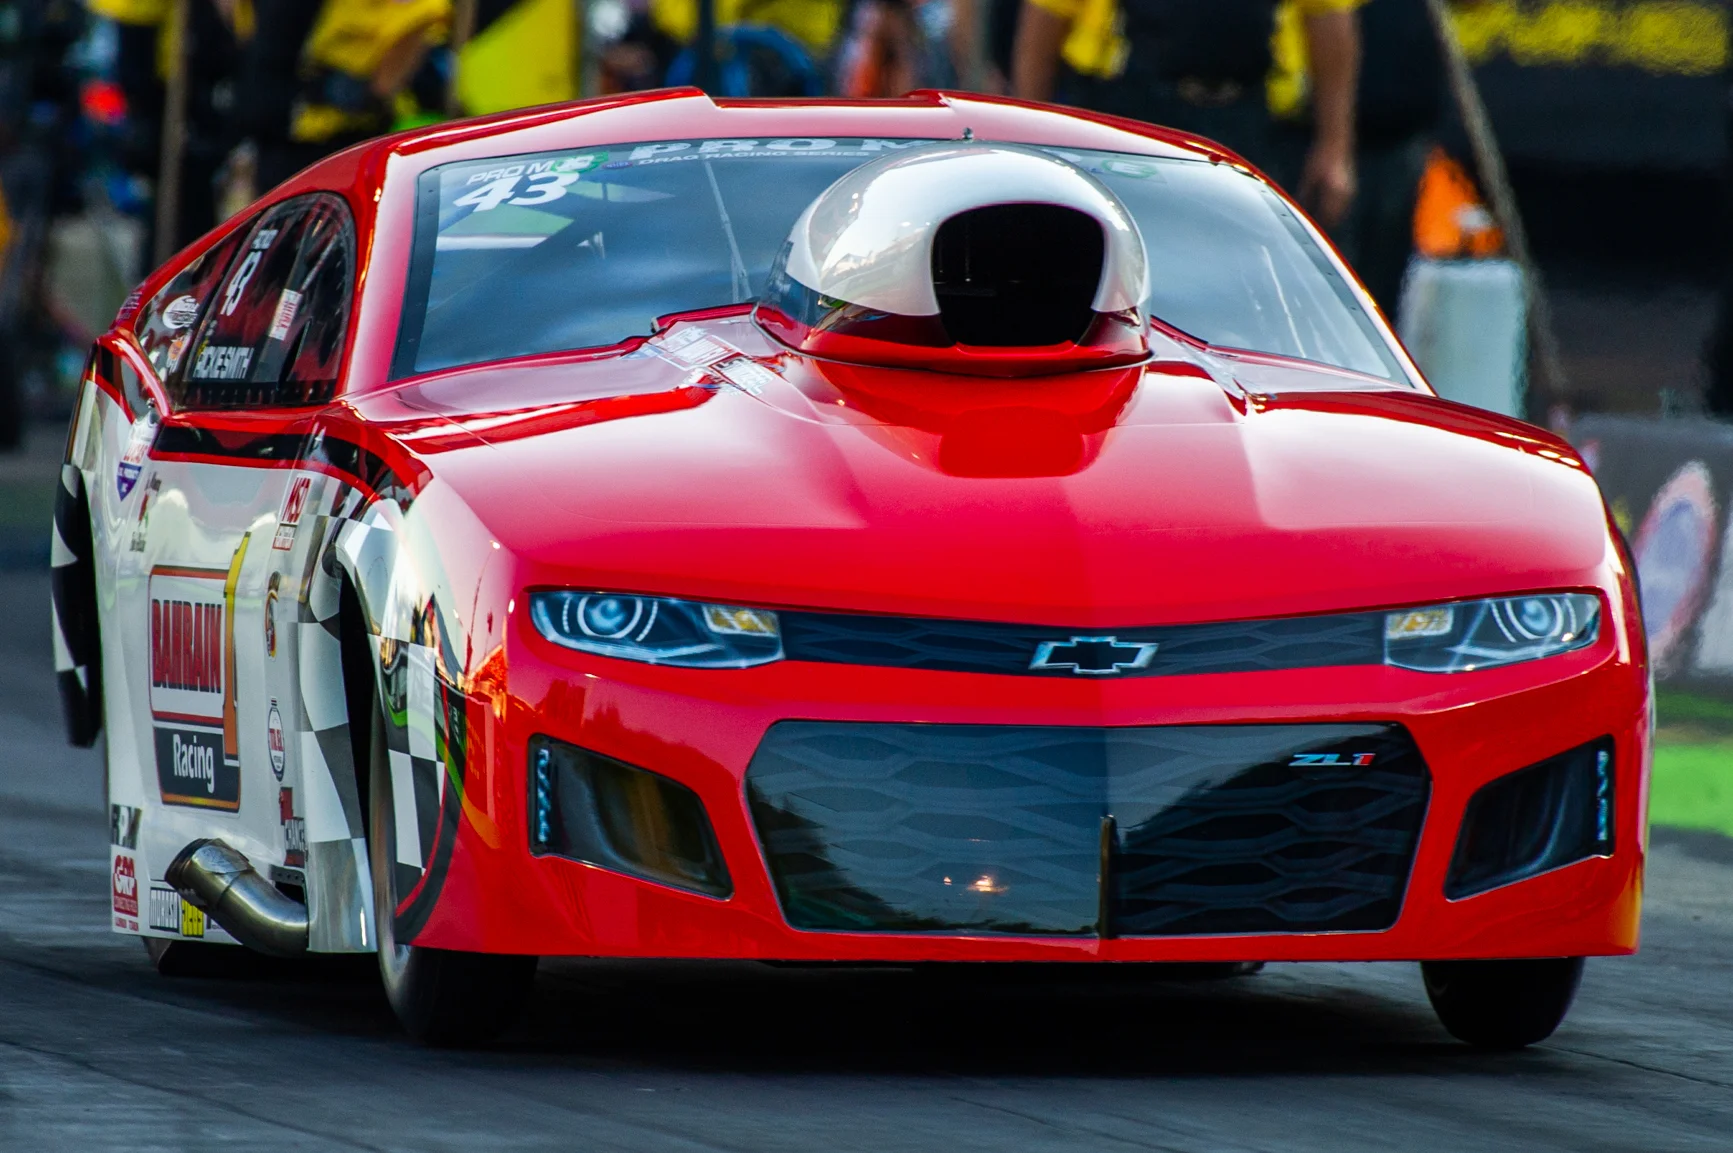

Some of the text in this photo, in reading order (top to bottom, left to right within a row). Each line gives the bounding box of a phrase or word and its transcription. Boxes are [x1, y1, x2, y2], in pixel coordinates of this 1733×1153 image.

[628, 138, 837, 160] PRO
[638, 155, 698, 165] DRAG
[705, 150, 787, 159] RACING
[466, 165, 525, 185] PRO
[453, 171, 580, 212] 43
[220, 251, 262, 316] 43
[152, 599, 222, 694] BAHRAIN
[173, 734, 215, 794] Racing
[1288, 753, 1376, 766] ZL1
